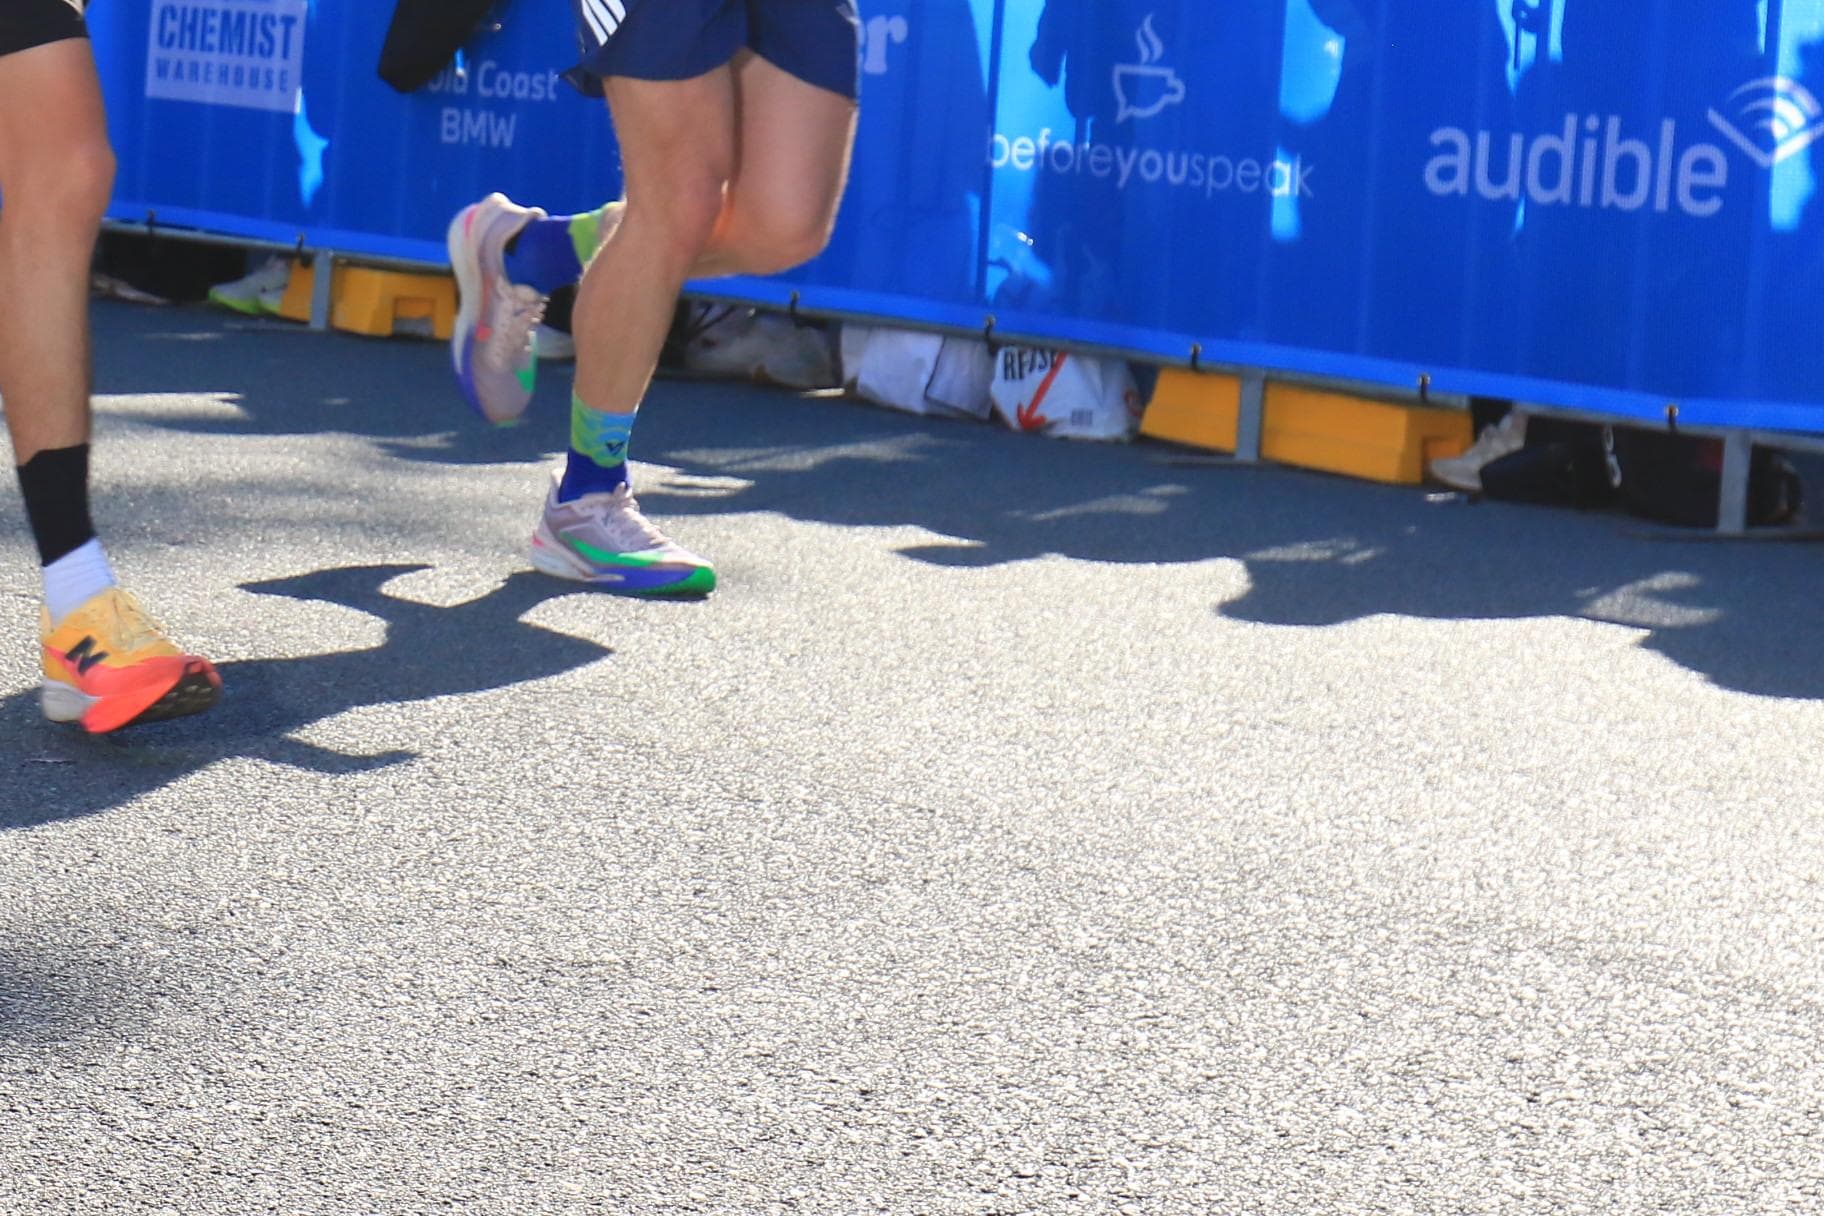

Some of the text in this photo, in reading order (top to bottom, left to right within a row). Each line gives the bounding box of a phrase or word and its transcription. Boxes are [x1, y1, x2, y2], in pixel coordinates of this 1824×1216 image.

[157, 3, 298, 61] CHEMIST
[155, 55, 290, 94] WAREHOUSE
[428, 59, 560, 102] old Coast
[439, 105, 518, 150] BMW
[986, 124, 1314, 199] beforeyouspeak
[1421, 112, 1730, 218] audible
